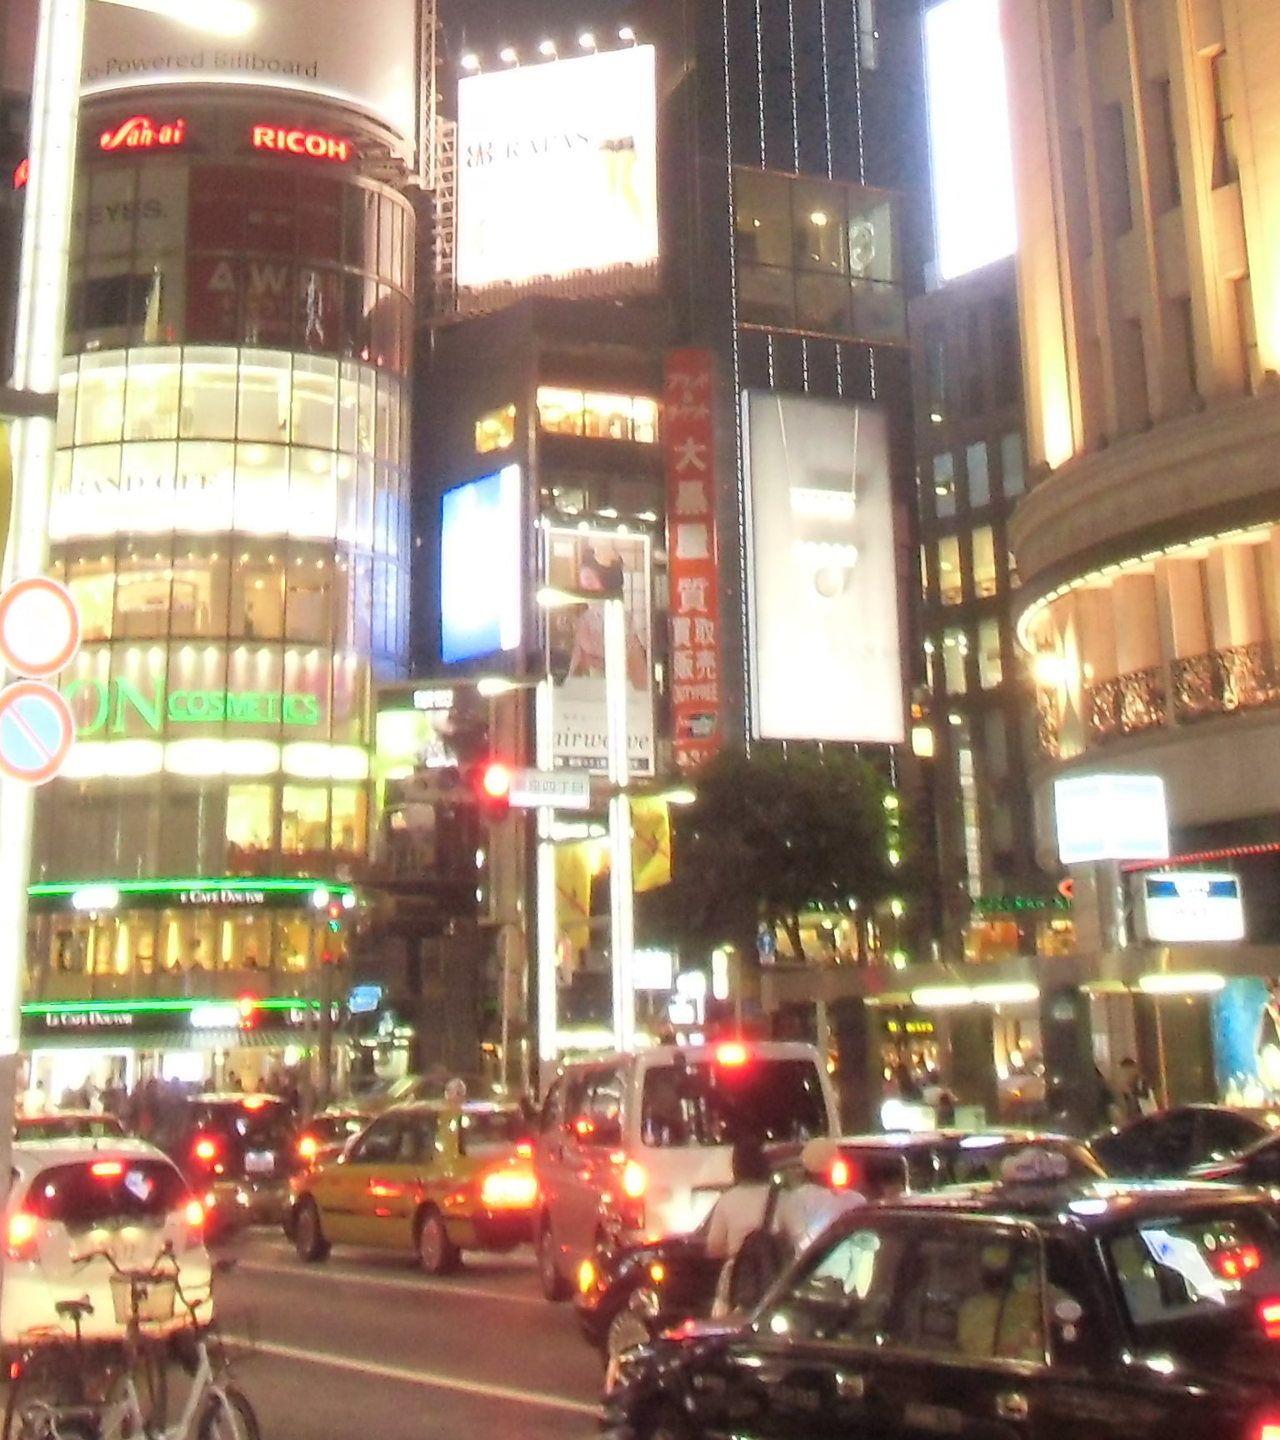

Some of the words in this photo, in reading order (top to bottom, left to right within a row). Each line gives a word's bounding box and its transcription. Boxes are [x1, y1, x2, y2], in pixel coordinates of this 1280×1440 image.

[106, 52, 204, 79] Powered
[213, 51, 318, 79] Billboard
[252, 126, 348, 160] RICOH
[168, 690, 319, 726] COSMETICS
